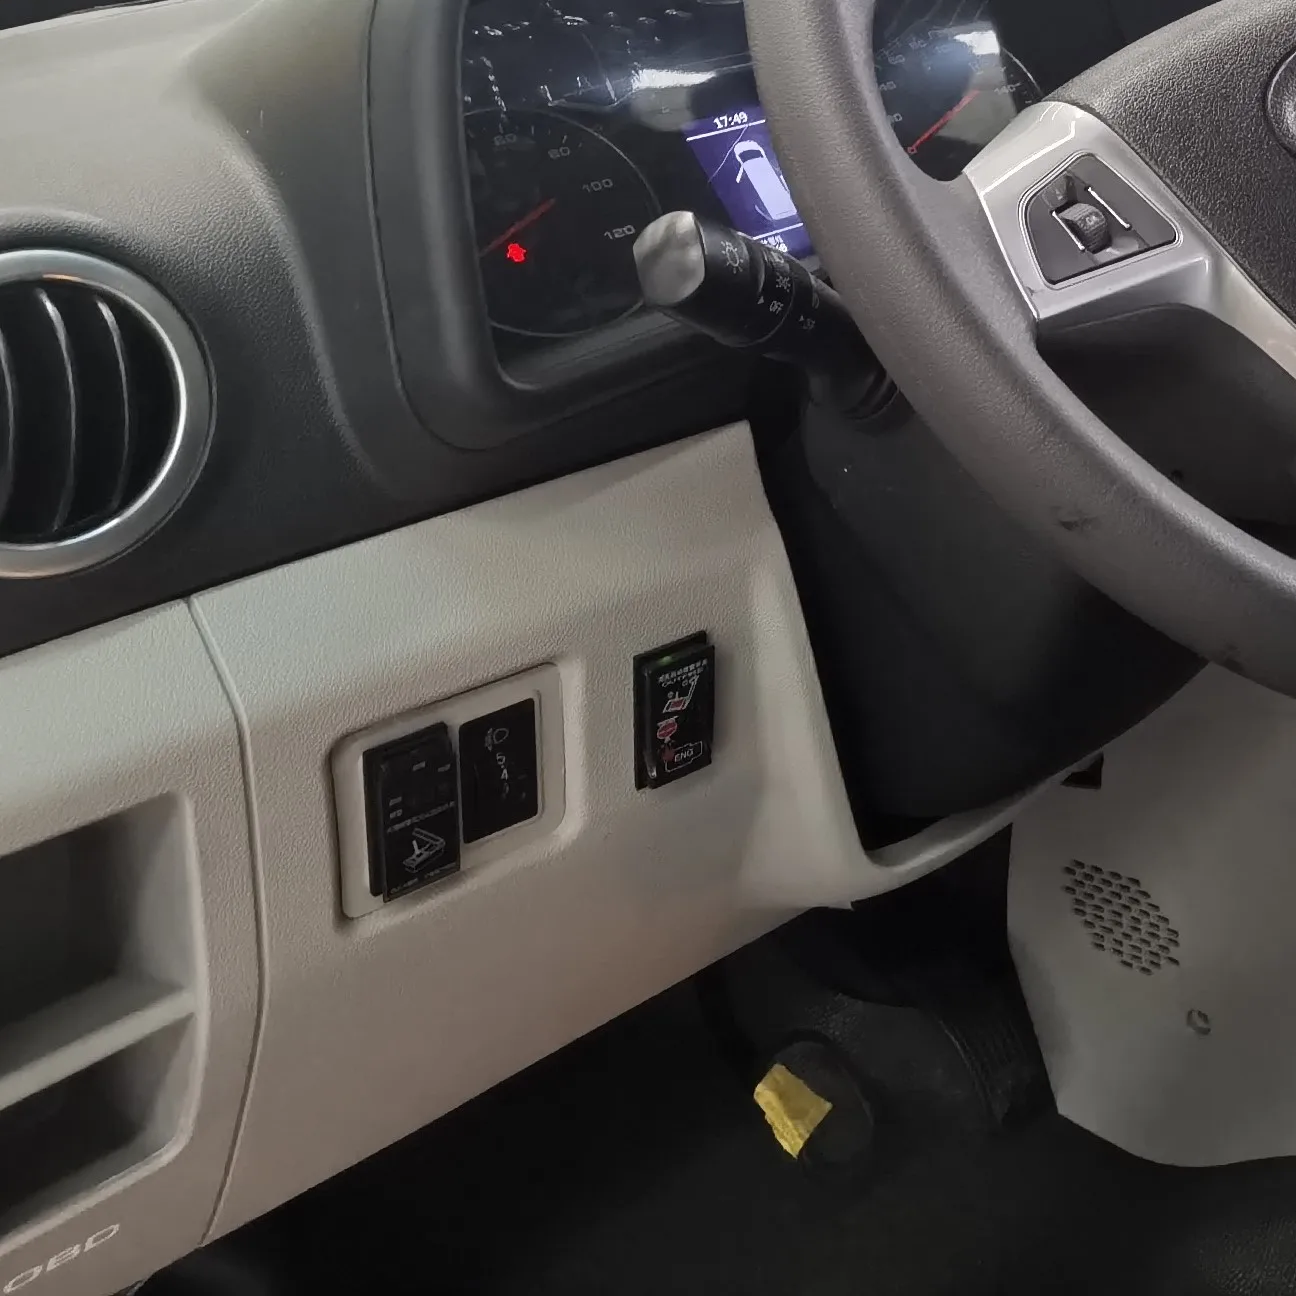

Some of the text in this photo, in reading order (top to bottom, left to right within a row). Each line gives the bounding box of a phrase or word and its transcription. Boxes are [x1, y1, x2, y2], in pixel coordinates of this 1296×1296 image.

[713, 111, 748, 129] 17:49
[582, 178, 613, 193] 100
[603, 224, 635, 240] 120
[3, 1223, 120, 1294] OBD
